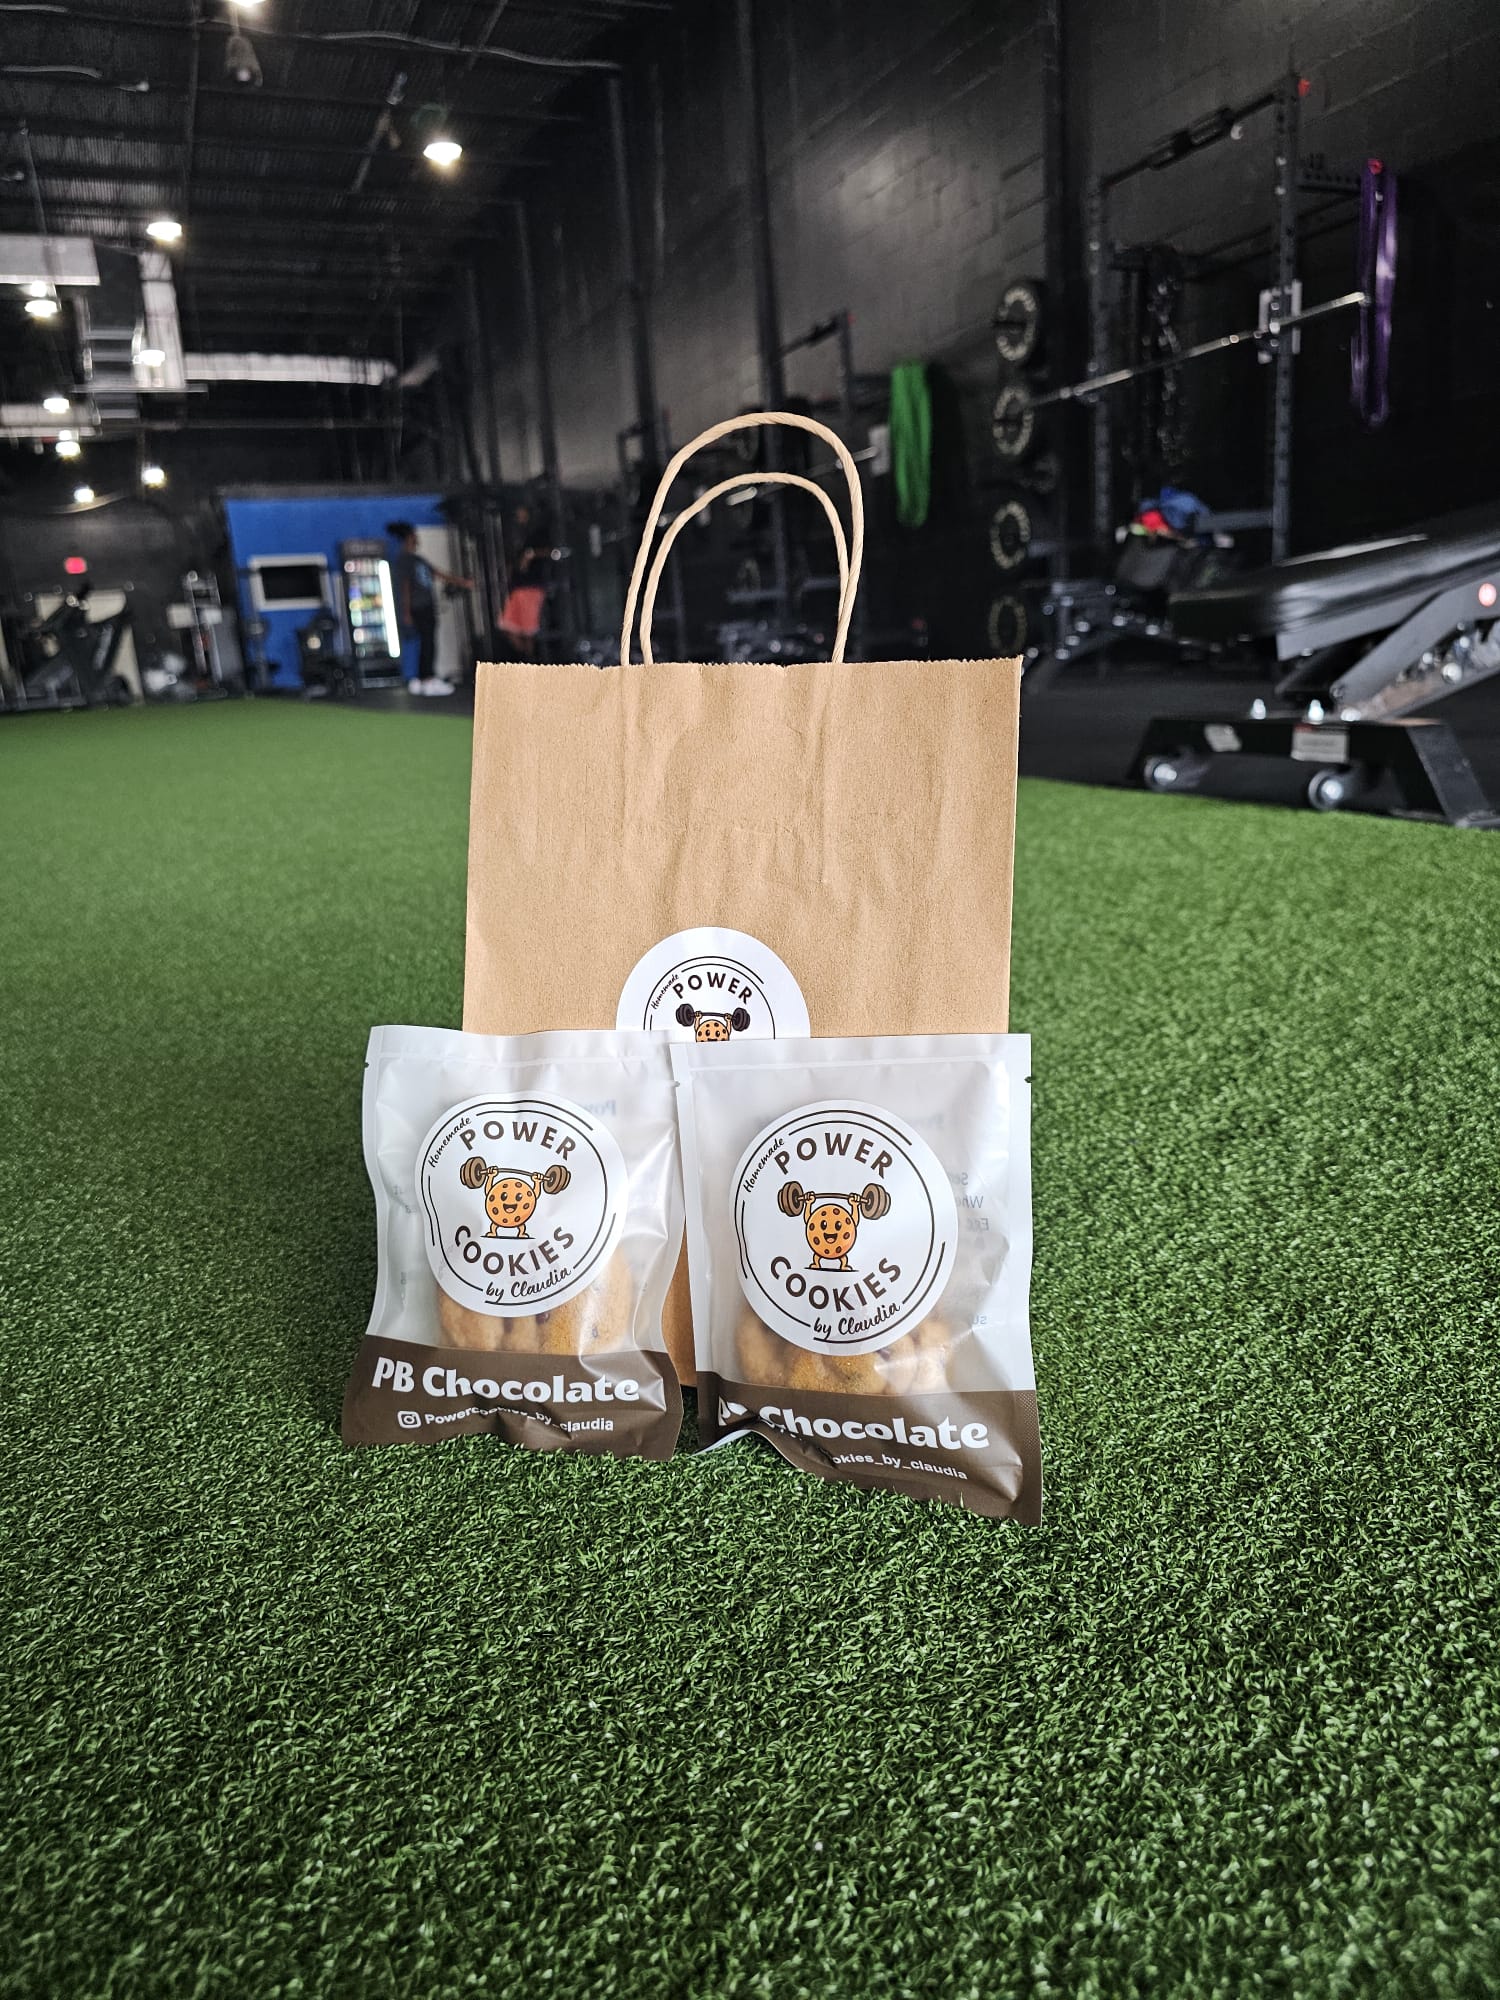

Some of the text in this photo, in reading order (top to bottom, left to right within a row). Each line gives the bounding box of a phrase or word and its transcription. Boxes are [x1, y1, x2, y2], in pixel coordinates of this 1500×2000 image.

[650, 973, 680, 1010] Homemade
[672, 971, 753, 1005] POWER
[427, 1116, 472, 1168] Homemade
[459, 1120, 576, 1160] POWER
[774, 1132, 893, 1179] POWER
[743, 1137, 785, 1193] Homemade
[454, 1225, 575, 1276] COOKIES
[486, 1266, 572, 1304] by Claudia
[770, 1257, 902, 1313] COOKIES
[813, 1302, 901, 1341] by Claudia
[371, 1356, 640, 1403] PB Chocolate
[759, 1405, 990, 1450] Chocolate
